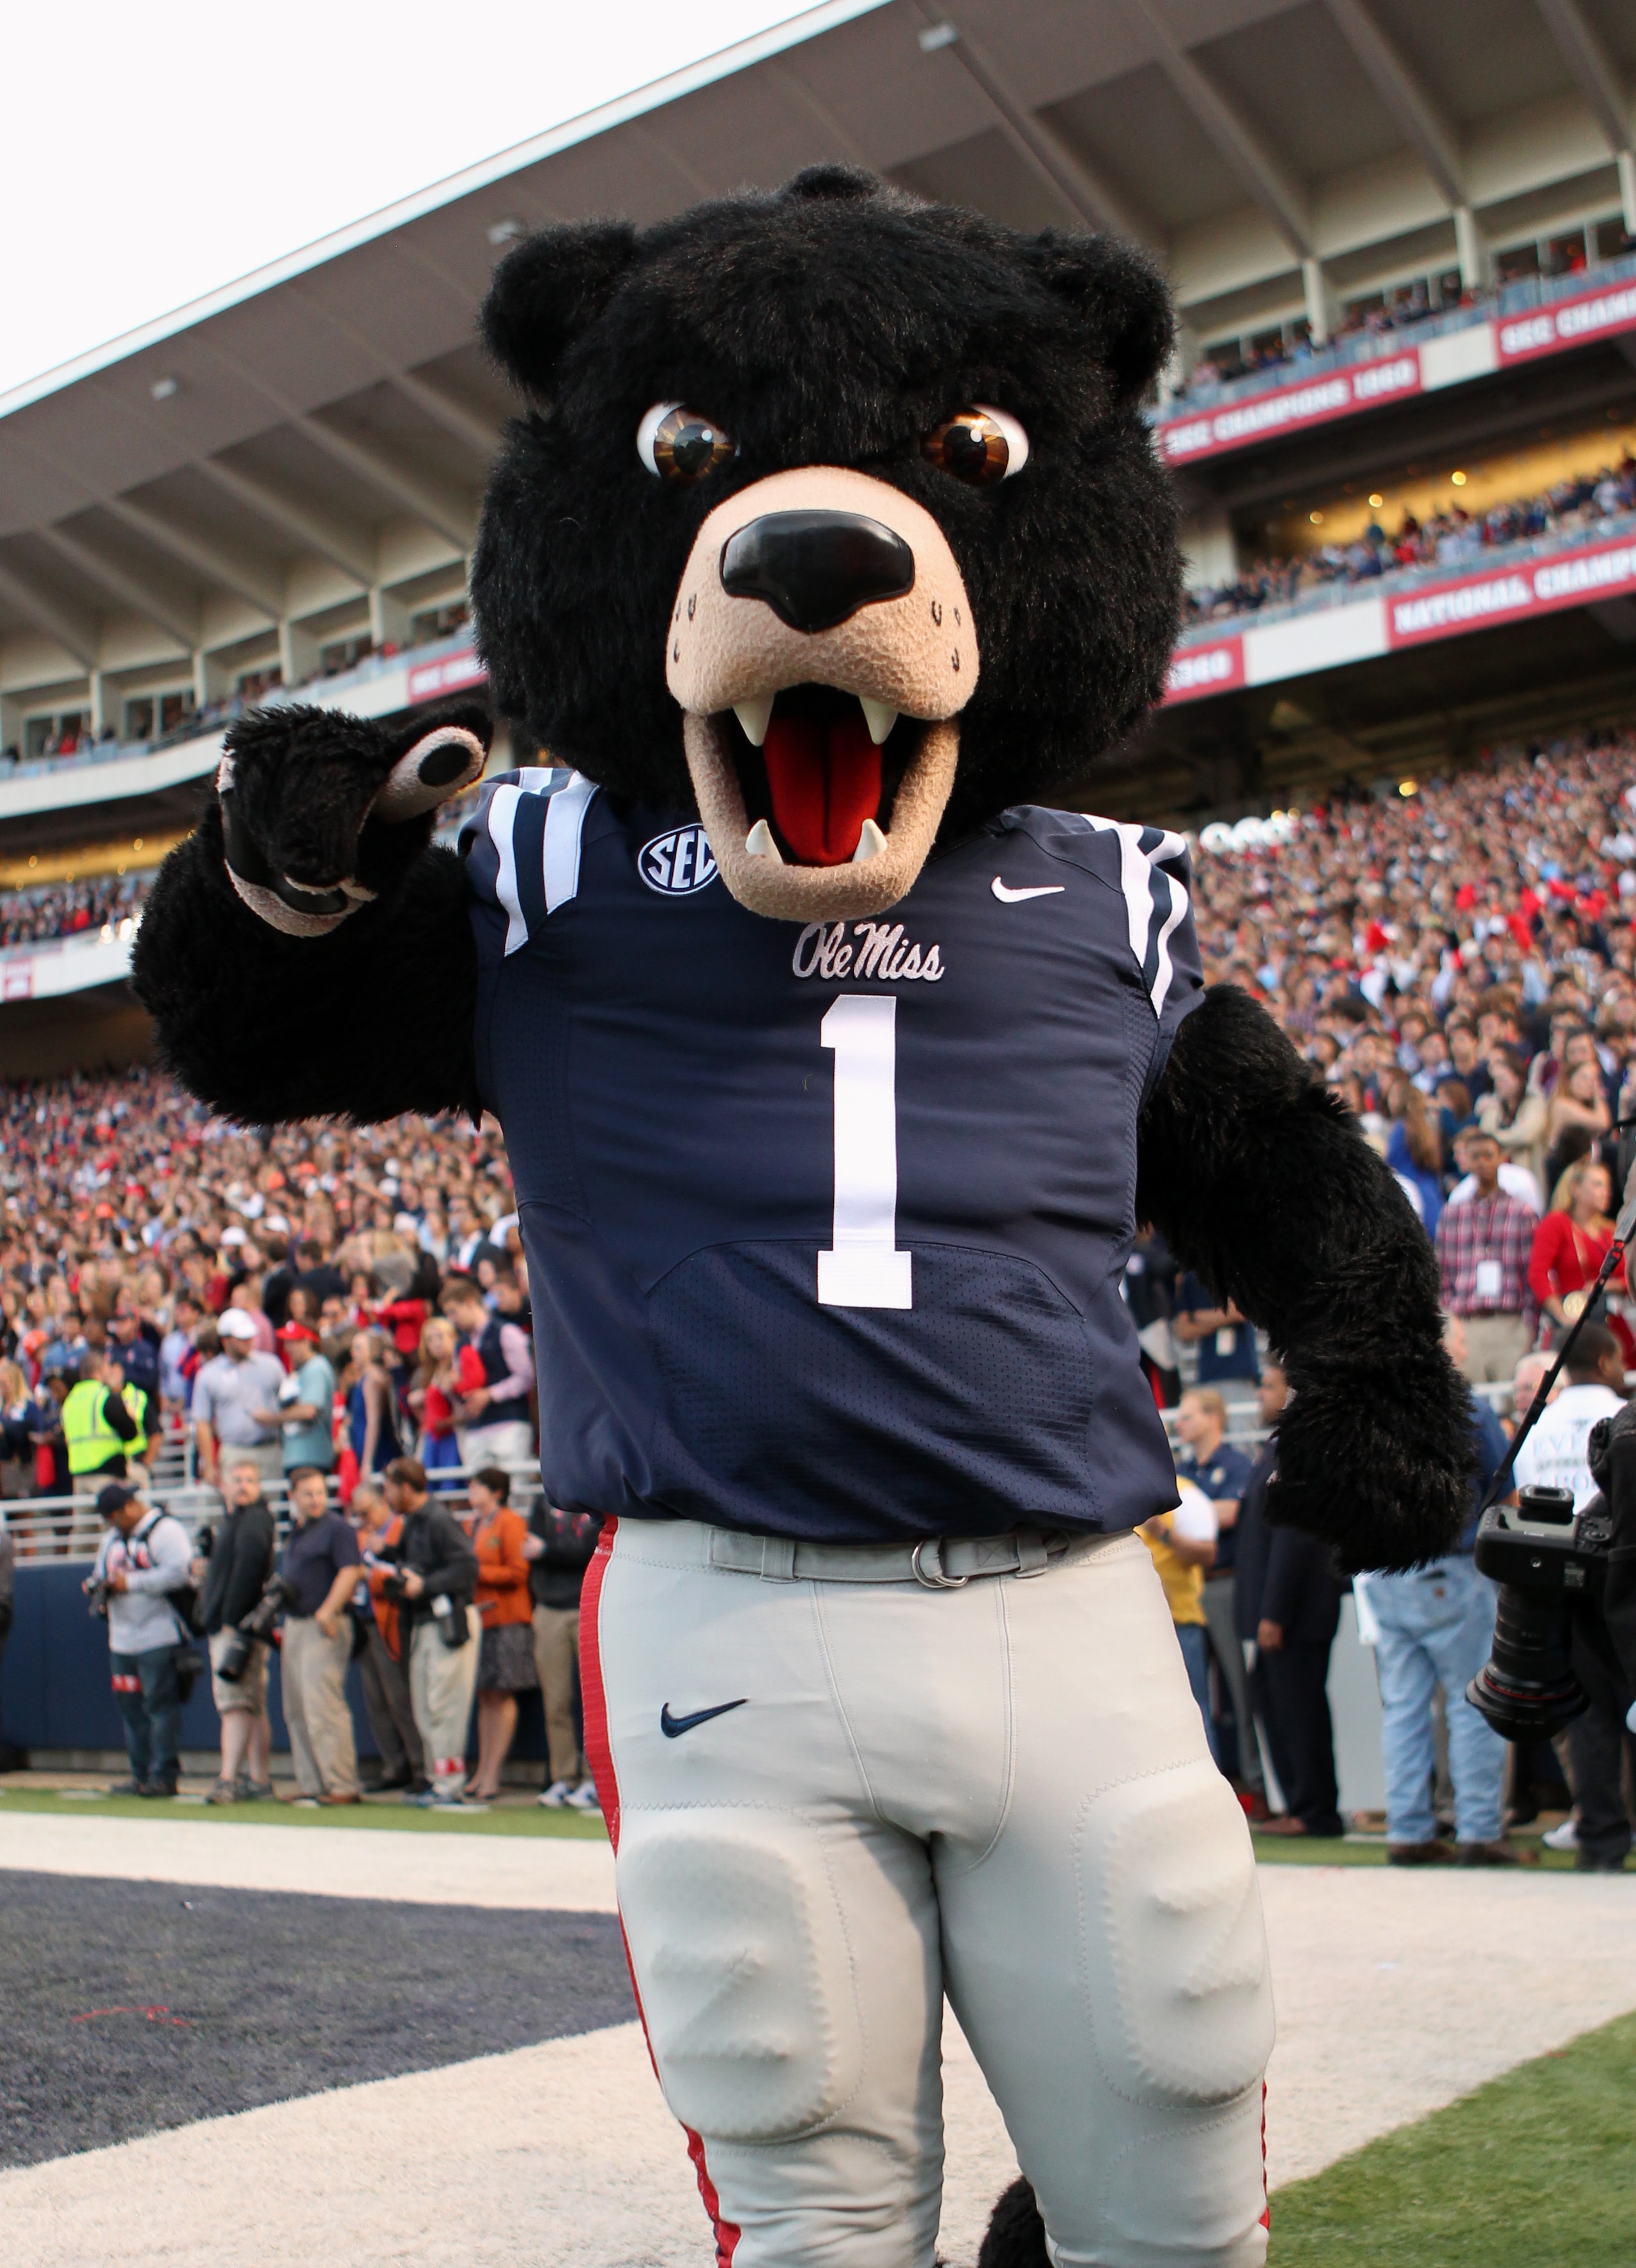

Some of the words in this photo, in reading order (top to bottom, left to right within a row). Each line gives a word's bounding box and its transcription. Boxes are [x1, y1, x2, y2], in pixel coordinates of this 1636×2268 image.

[1214, 378, 1350, 442] CHAMPIONS
[1393, 574, 1532, 635] NATIONAL
[647, 829, 716, 889] SEC
[792, 922, 853, 979] Ole
[854, 922, 946, 982] Miss
[818, 994, 912, 1310] 1
